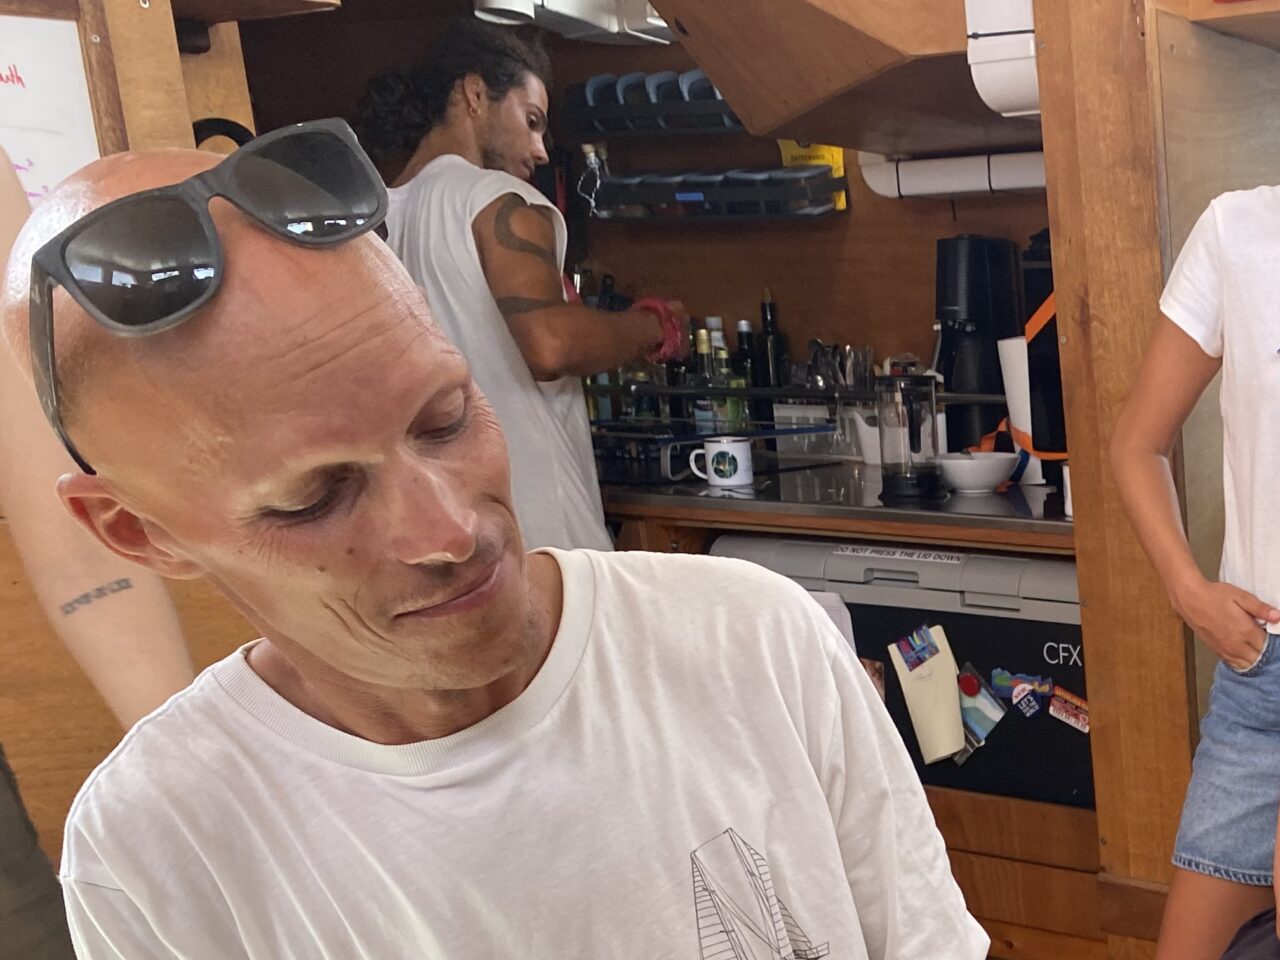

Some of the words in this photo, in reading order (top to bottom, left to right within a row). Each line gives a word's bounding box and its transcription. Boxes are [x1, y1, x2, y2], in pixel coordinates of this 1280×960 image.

[869, 549, 896, 557] PRESS
[899, 551, 915, 559] THE
[917, 552, 931, 560] LID
[933, 554, 961, 562] DOWN
[1043, 642, 1082, 667] CFX
